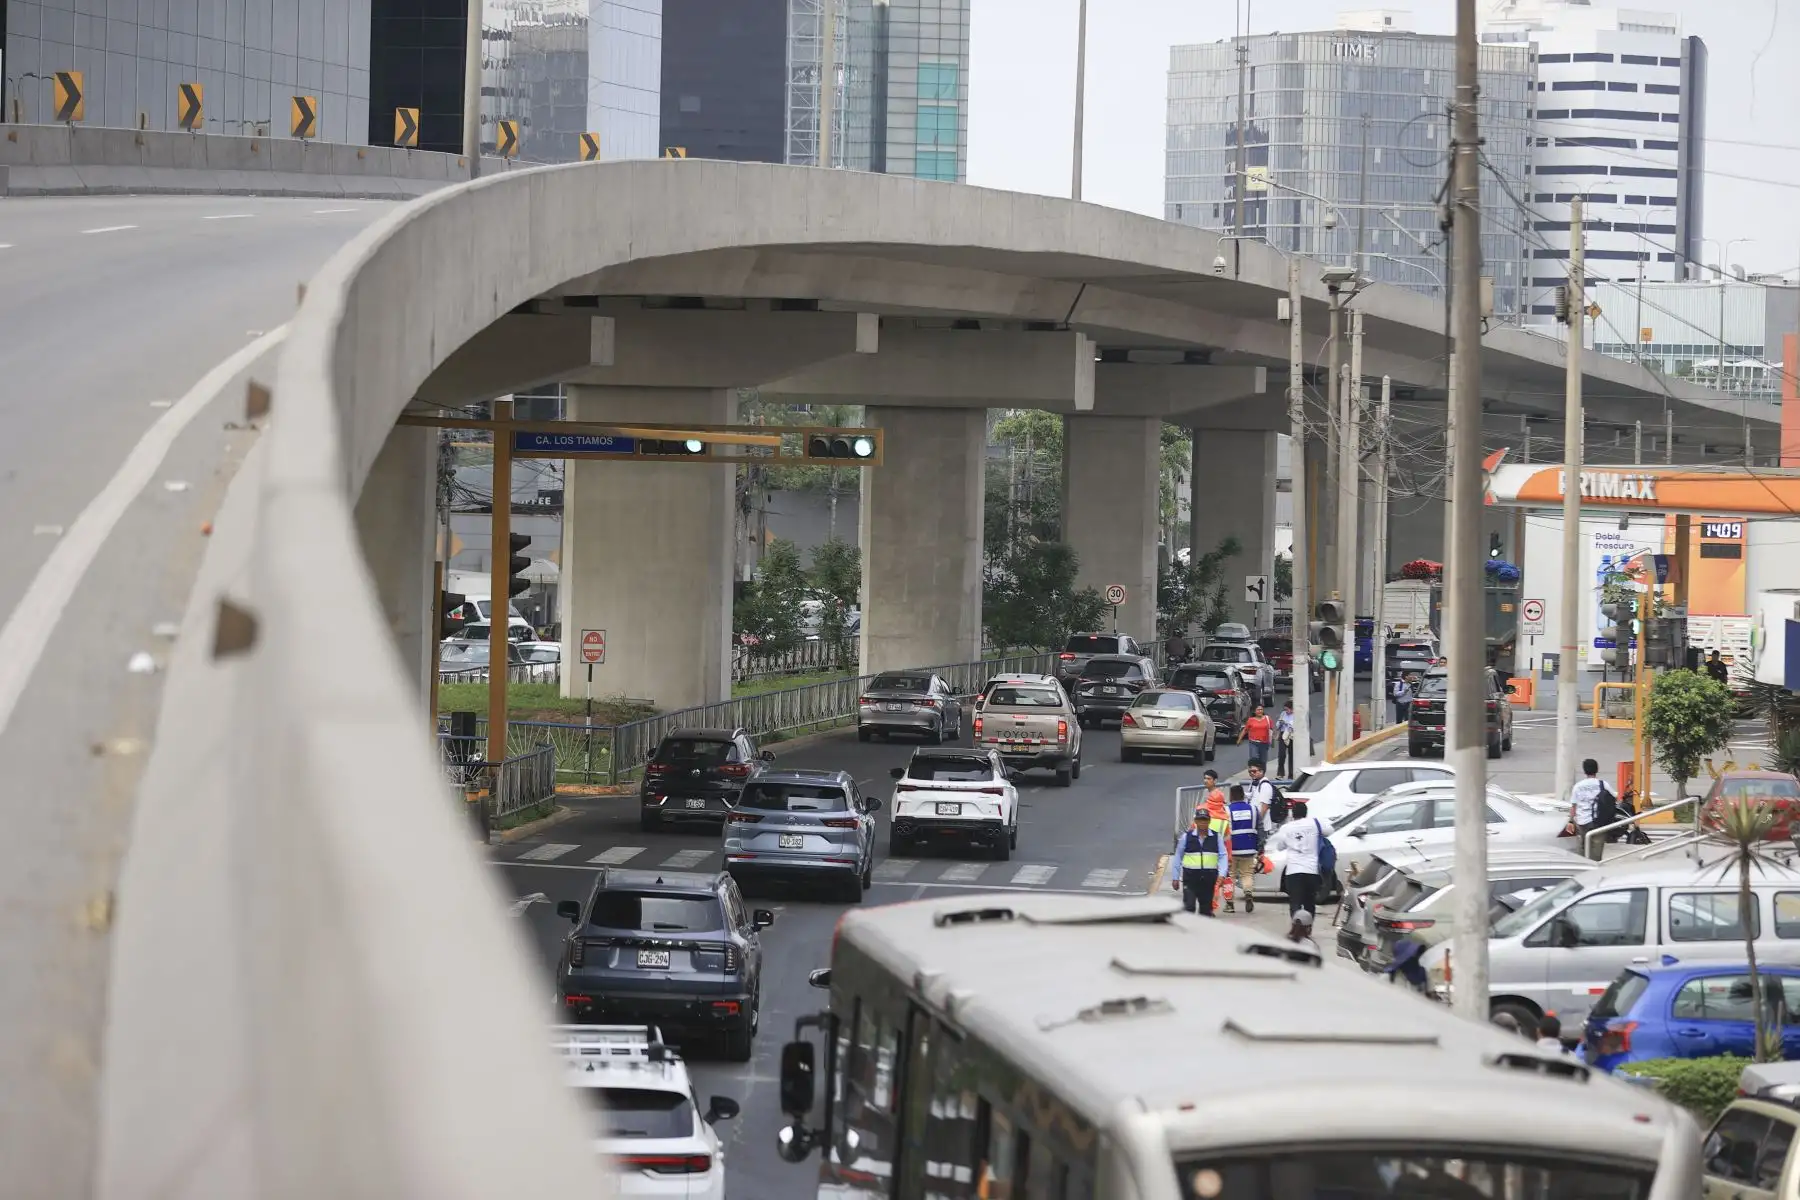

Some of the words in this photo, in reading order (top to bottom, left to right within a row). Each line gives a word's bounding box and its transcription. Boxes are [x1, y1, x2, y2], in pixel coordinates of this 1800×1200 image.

[535, 436, 552, 445] CA.
[554, 436, 574, 445] LOS
[576, 436, 613, 446] TIAMOS
[1595, 532, 1621, 541] Doble
[1595, 541, 1634, 550] frescura
[1110, 589, 1121, 598] 30
[996, 730, 1045, 739] TOYOTA
[639, 953, 669, 964] CJG-294
